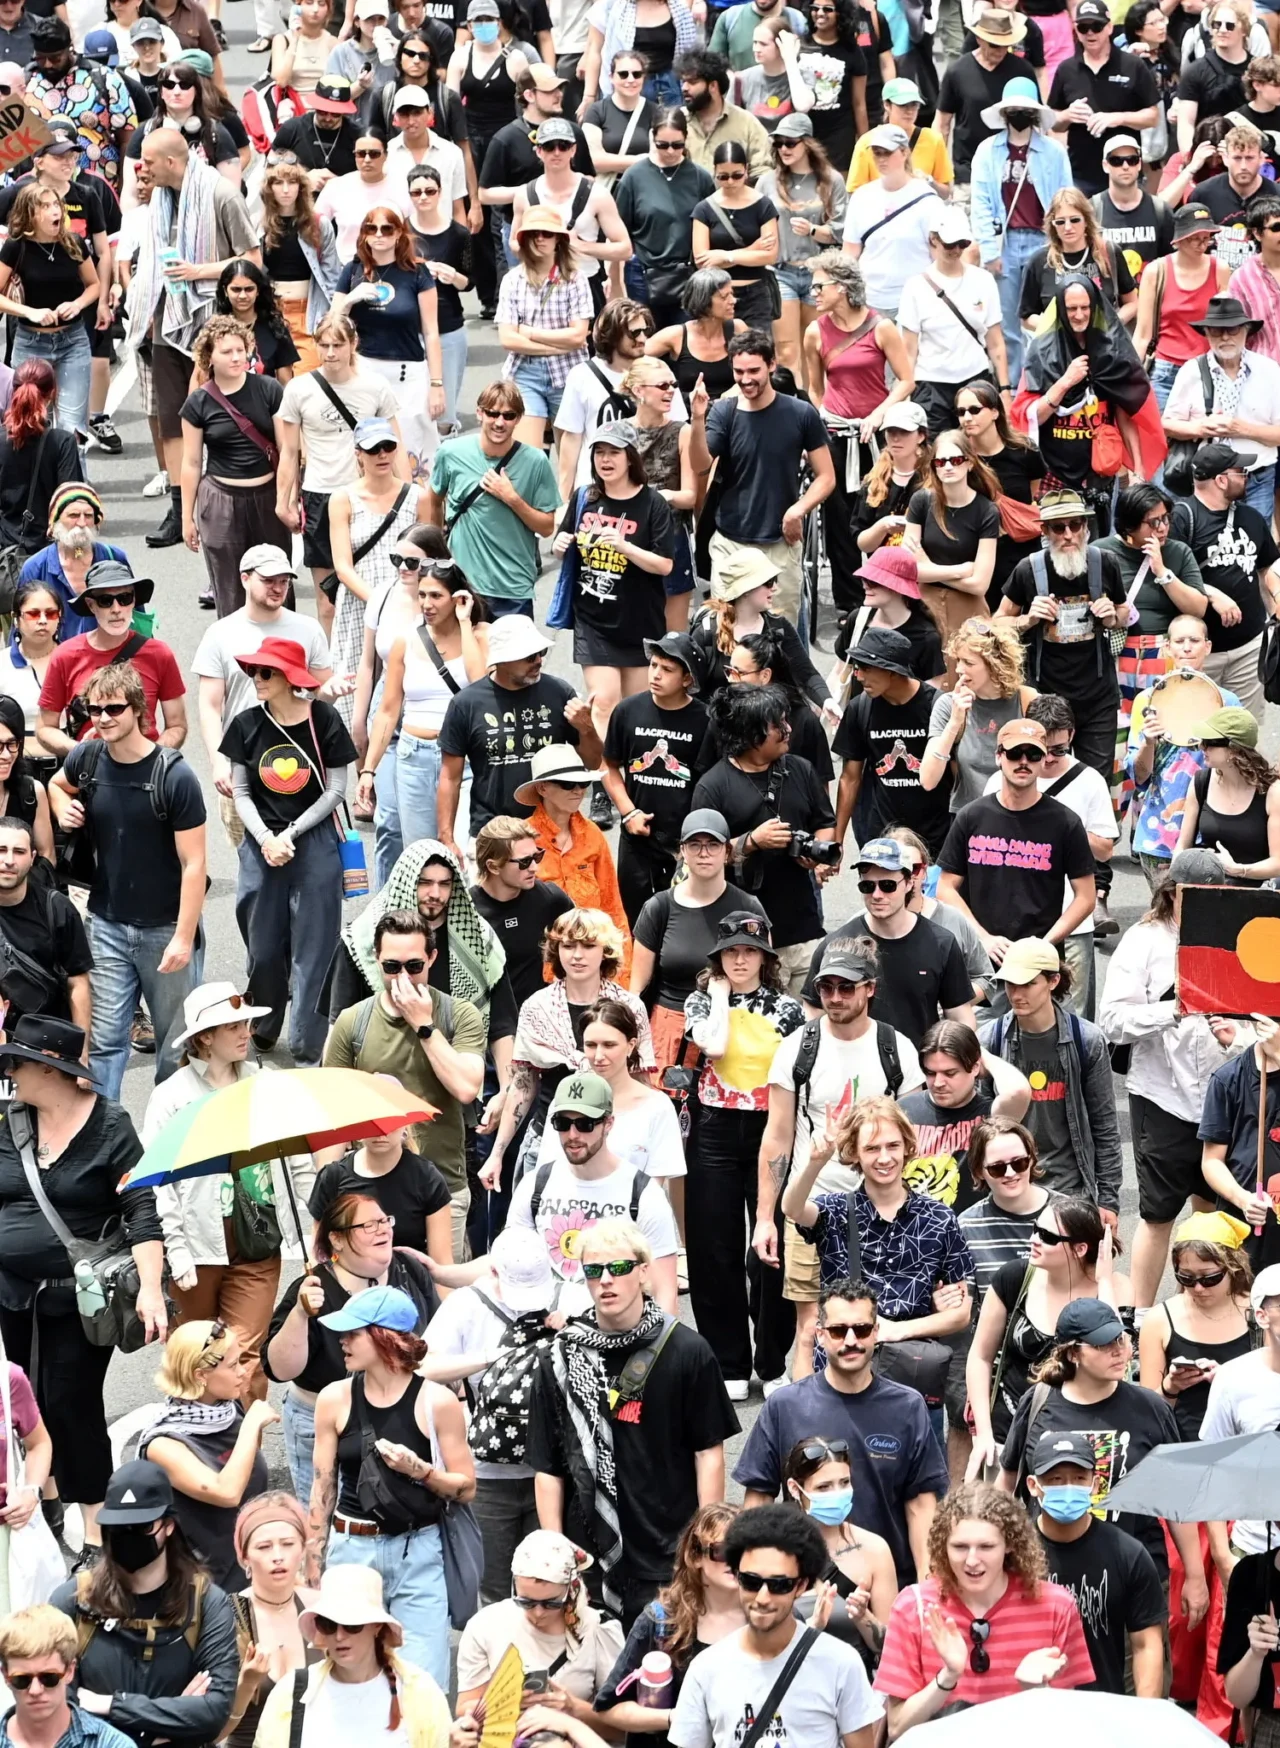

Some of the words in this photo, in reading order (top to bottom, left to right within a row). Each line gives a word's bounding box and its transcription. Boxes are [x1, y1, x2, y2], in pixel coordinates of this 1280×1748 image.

[1052, 427, 1093, 441] HISTO
[634, 726, 693, 742] BLACKFULLAS
[870, 728, 927, 740] BLACKFULLAS
